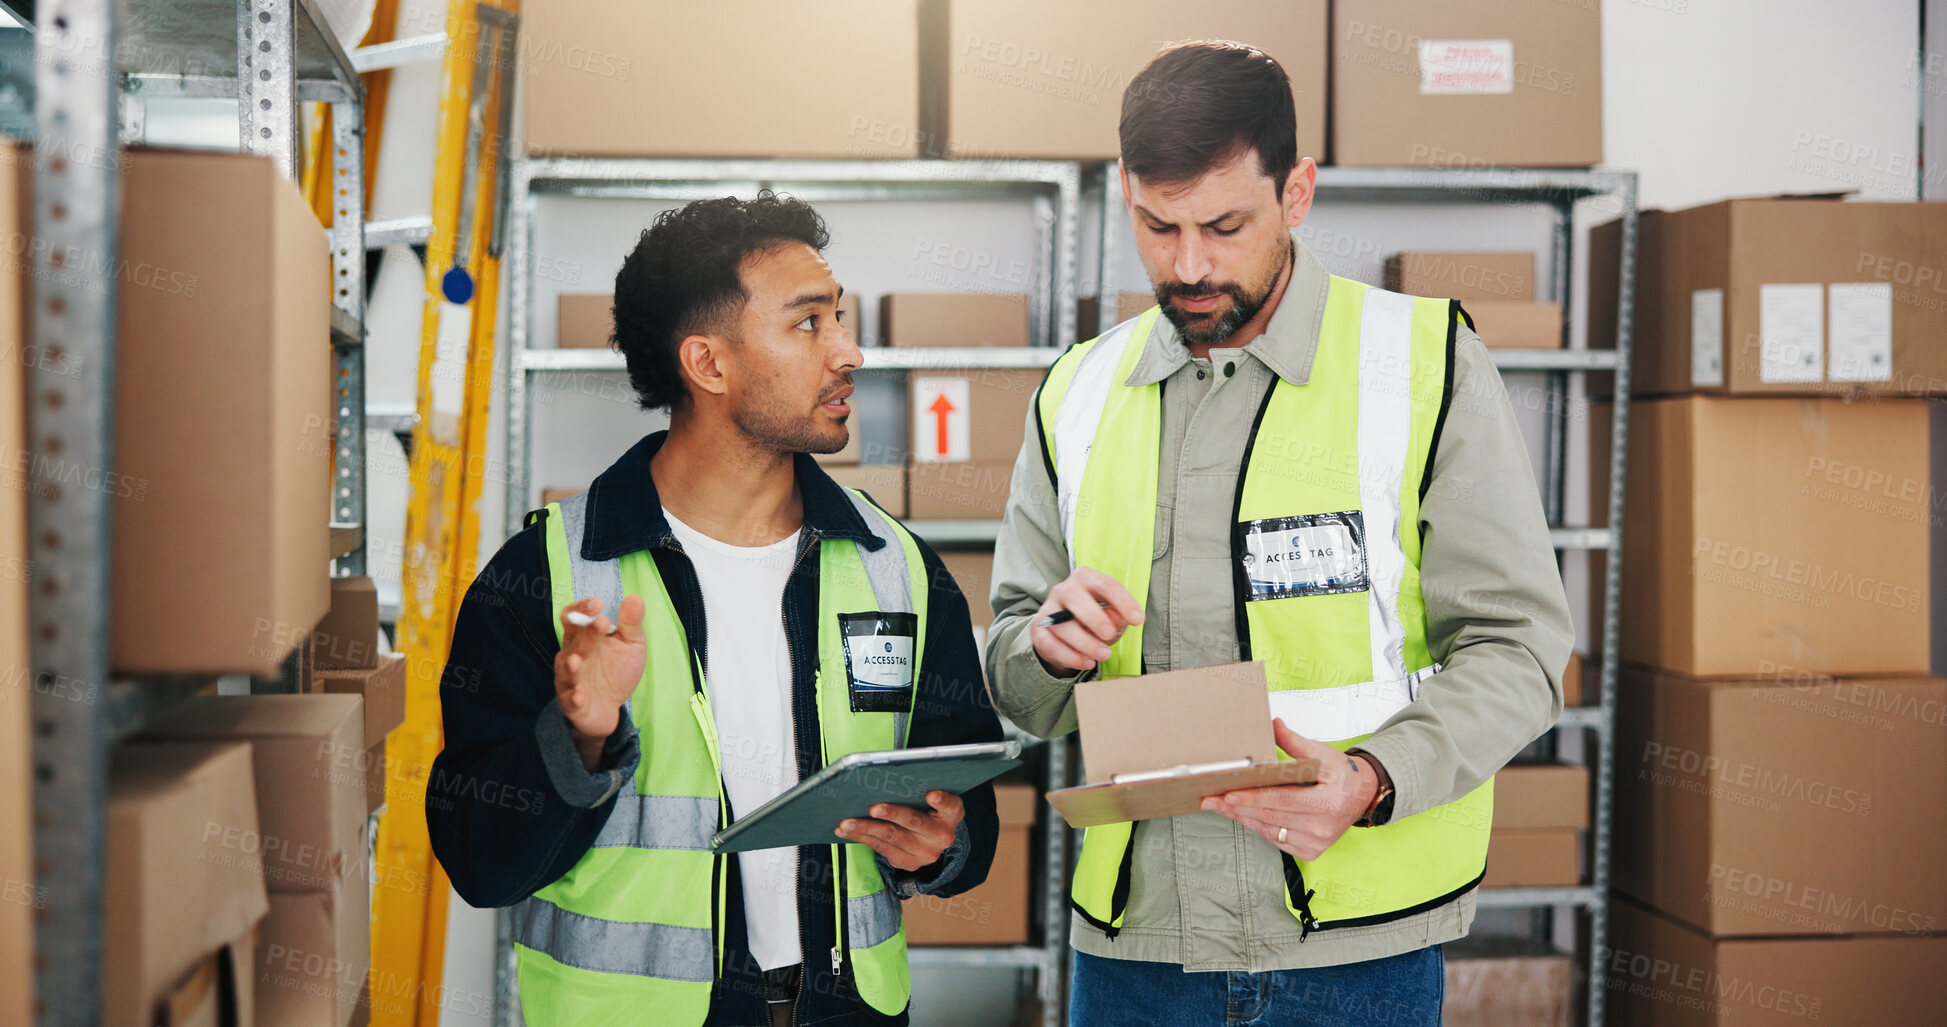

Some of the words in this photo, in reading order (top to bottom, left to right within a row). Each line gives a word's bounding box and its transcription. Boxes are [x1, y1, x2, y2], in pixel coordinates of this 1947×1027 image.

[1266, 551, 1307, 564] ACCES
[1311, 548, 1334, 558] TAG
[864, 656, 895, 665] ACCESS
[896, 656, 907, 666] TAG
